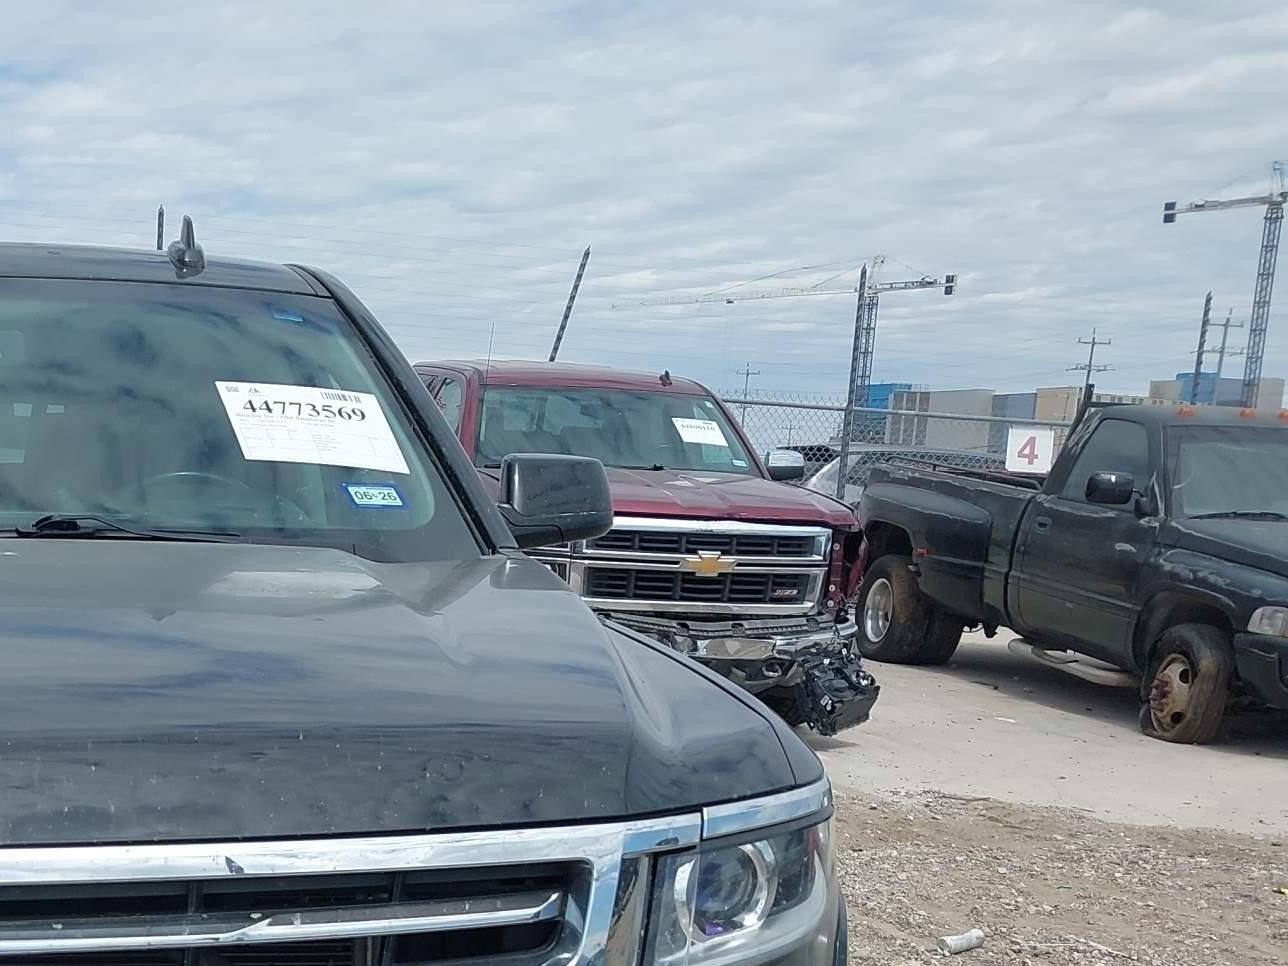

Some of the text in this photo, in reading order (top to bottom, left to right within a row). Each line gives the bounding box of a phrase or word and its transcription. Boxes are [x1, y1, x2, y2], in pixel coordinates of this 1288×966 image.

[243, 399, 366, 422] 44773569
[1017, 436, 1039, 465] 4
[354, 491, 397, 501] 06 26
